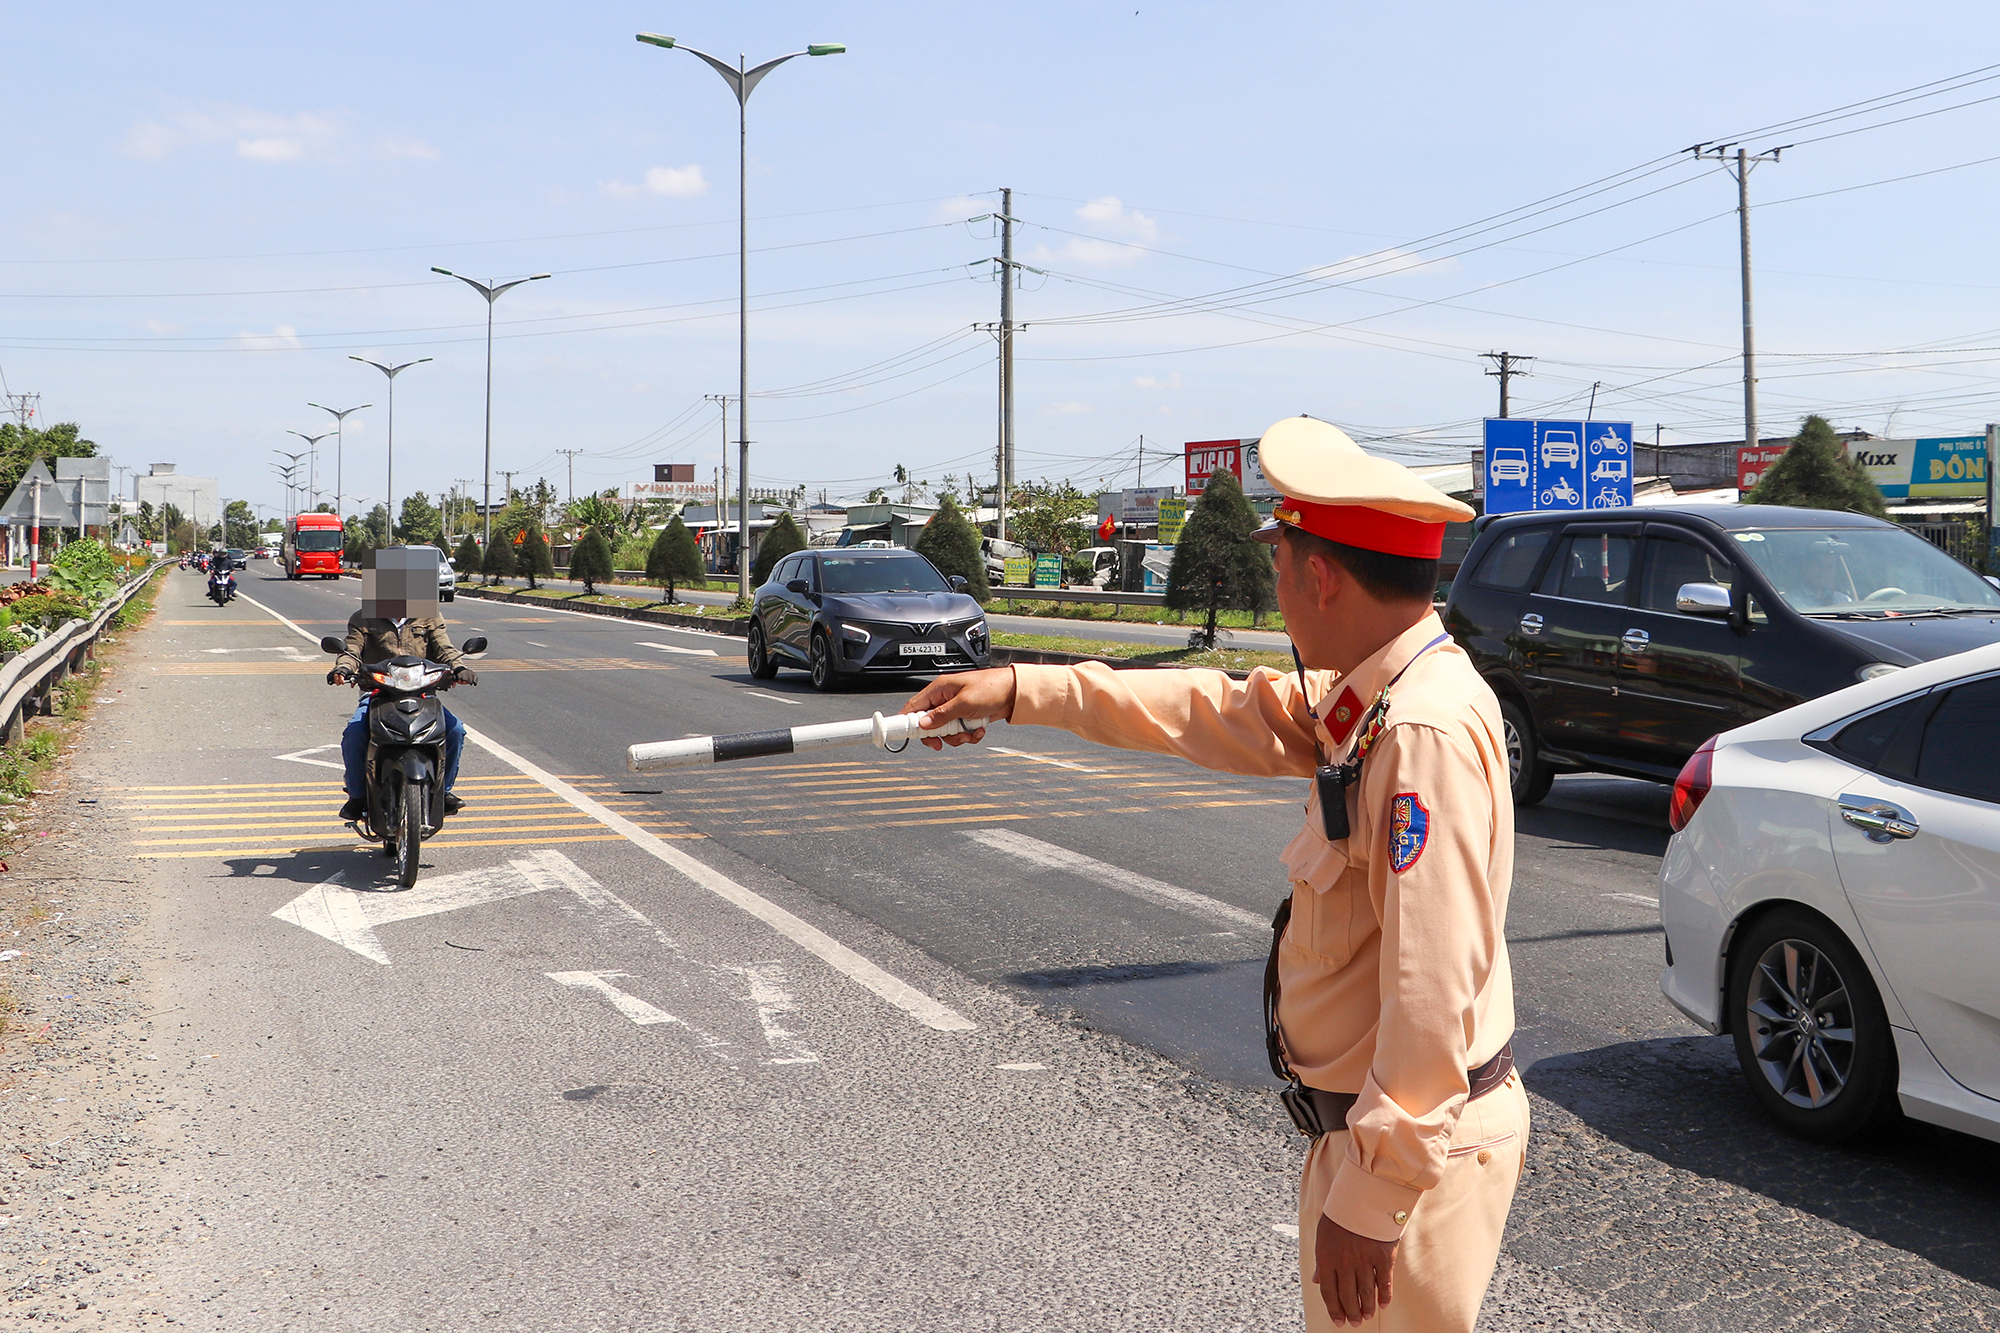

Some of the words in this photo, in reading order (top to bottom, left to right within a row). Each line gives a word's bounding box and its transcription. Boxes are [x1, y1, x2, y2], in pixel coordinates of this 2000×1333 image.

[1939, 442, 1954, 452] PHỤ
[1955, 440, 1974, 451] TÙNG
[1741, 451, 1759, 465] Phụ
[1929, 453, 1987, 480] ĐÔN
[1160, 507, 1185, 519] TOÀN
